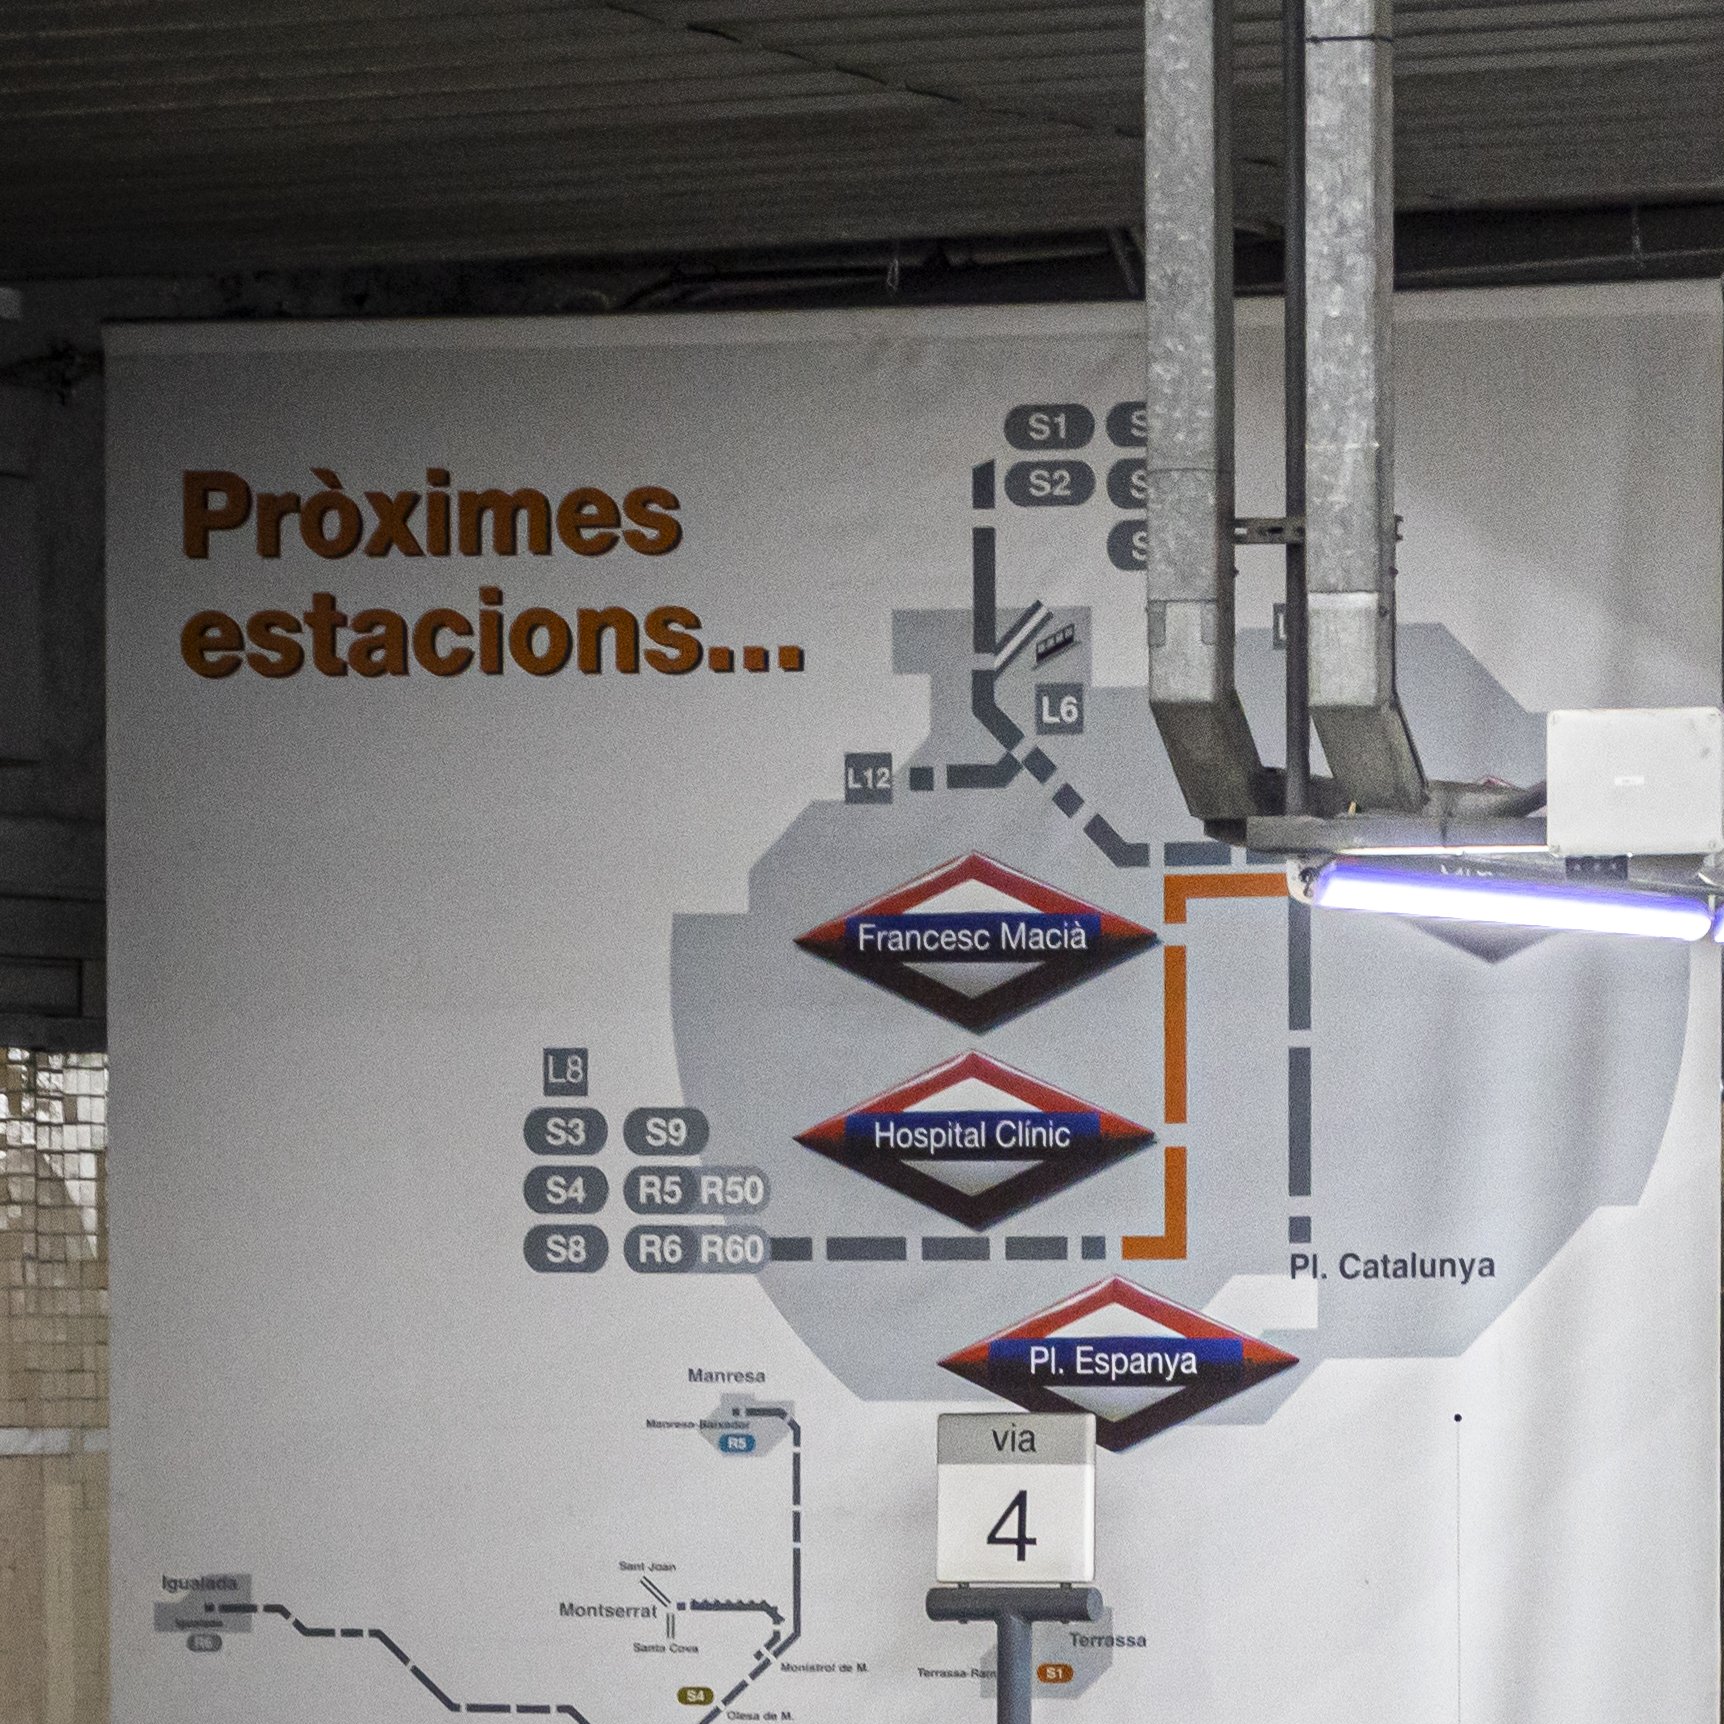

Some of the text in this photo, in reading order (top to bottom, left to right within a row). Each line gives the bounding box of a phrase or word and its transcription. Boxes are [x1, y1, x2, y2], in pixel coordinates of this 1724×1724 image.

[1028, 413, 1067, 441] S1
[1131, 410, 1147, 438] S
[1029, 469, 1071, 497] S2
[1131, 469, 1147, 500] S
[181, 466, 683, 560] Pròximes
[1132, 530, 1147, 560] S
[179, 585, 805, 678] estacions...
[1042, 695, 1078, 724] L6
[847, 764, 892, 791] L12
[857, 919, 1089, 954] Francesc Macià
[548, 1055, 585, 1085] L8
[545, 1116, 586, 1148] S3
[645, 1116, 687, 1149] S9
[873, 1116, 1071, 1154] Hospital Clínic
[545, 1174, 586, 1206] S4
[639, 1174, 763, 1206] R5 R50
[545, 1233, 586, 1265] S8
[639, 1233, 763, 1265] R6 R60
[1289, 1251, 1496, 1286] Pl. Catalunya
[688, 1367, 766, 1384] Manresa
[1029, 1346, 1198, 1384] Pl. Espanya
[728, 1436, 747, 1449] R5
[991, 1423, 1037, 1457] via
[986, 1490, 1038, 1564] 4
[162, 1575, 238, 1592] Igualada
[559, 1602, 657, 1619] Montserrat
[1071, 1632, 1147, 1649] Terrassa
[1046, 1668, 1063, 1680] S1
